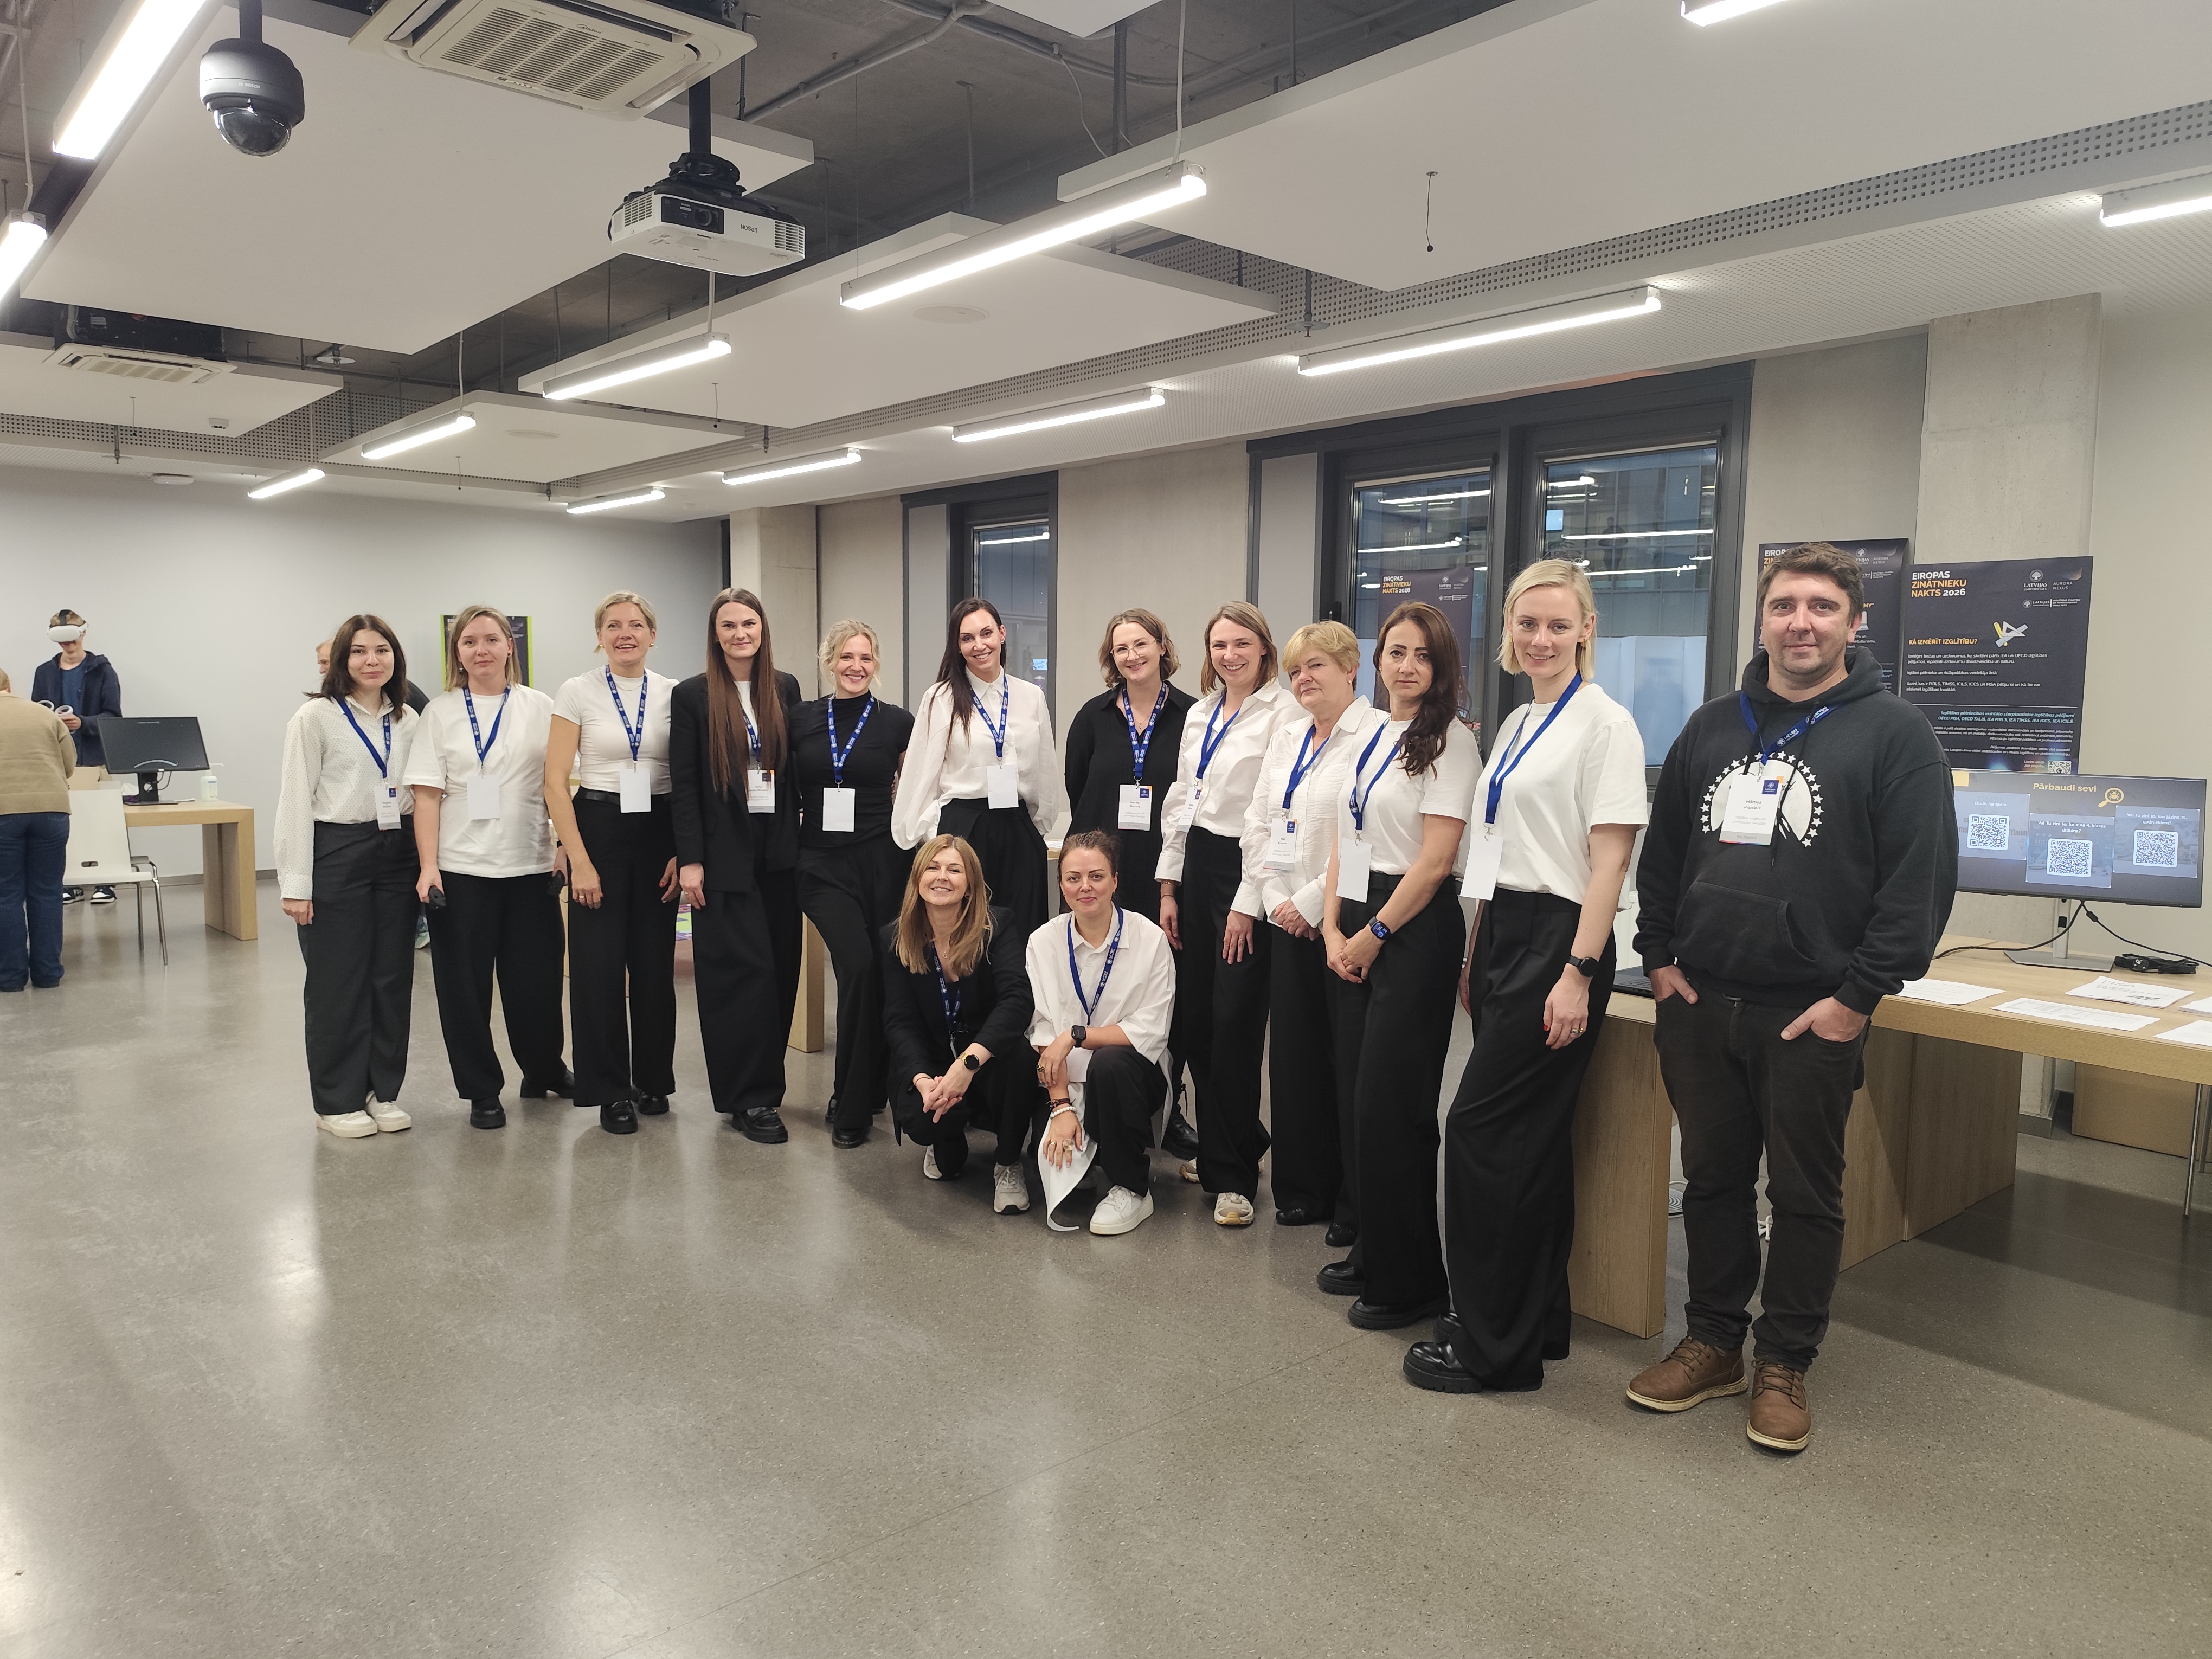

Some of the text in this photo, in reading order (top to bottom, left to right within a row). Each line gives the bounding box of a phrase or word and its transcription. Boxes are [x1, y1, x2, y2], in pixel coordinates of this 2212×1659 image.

[740, 224, 758, 233] EPSON
[1764, 549, 1789, 557] EIROP
[1912, 571, 1950, 580] EIROPAS
[1911, 578, 1967, 589] ZINĀTNIEKU
[1911, 588, 1966, 597] NAKTS 2026
[2033, 783, 2075, 792] Pārbaudi
